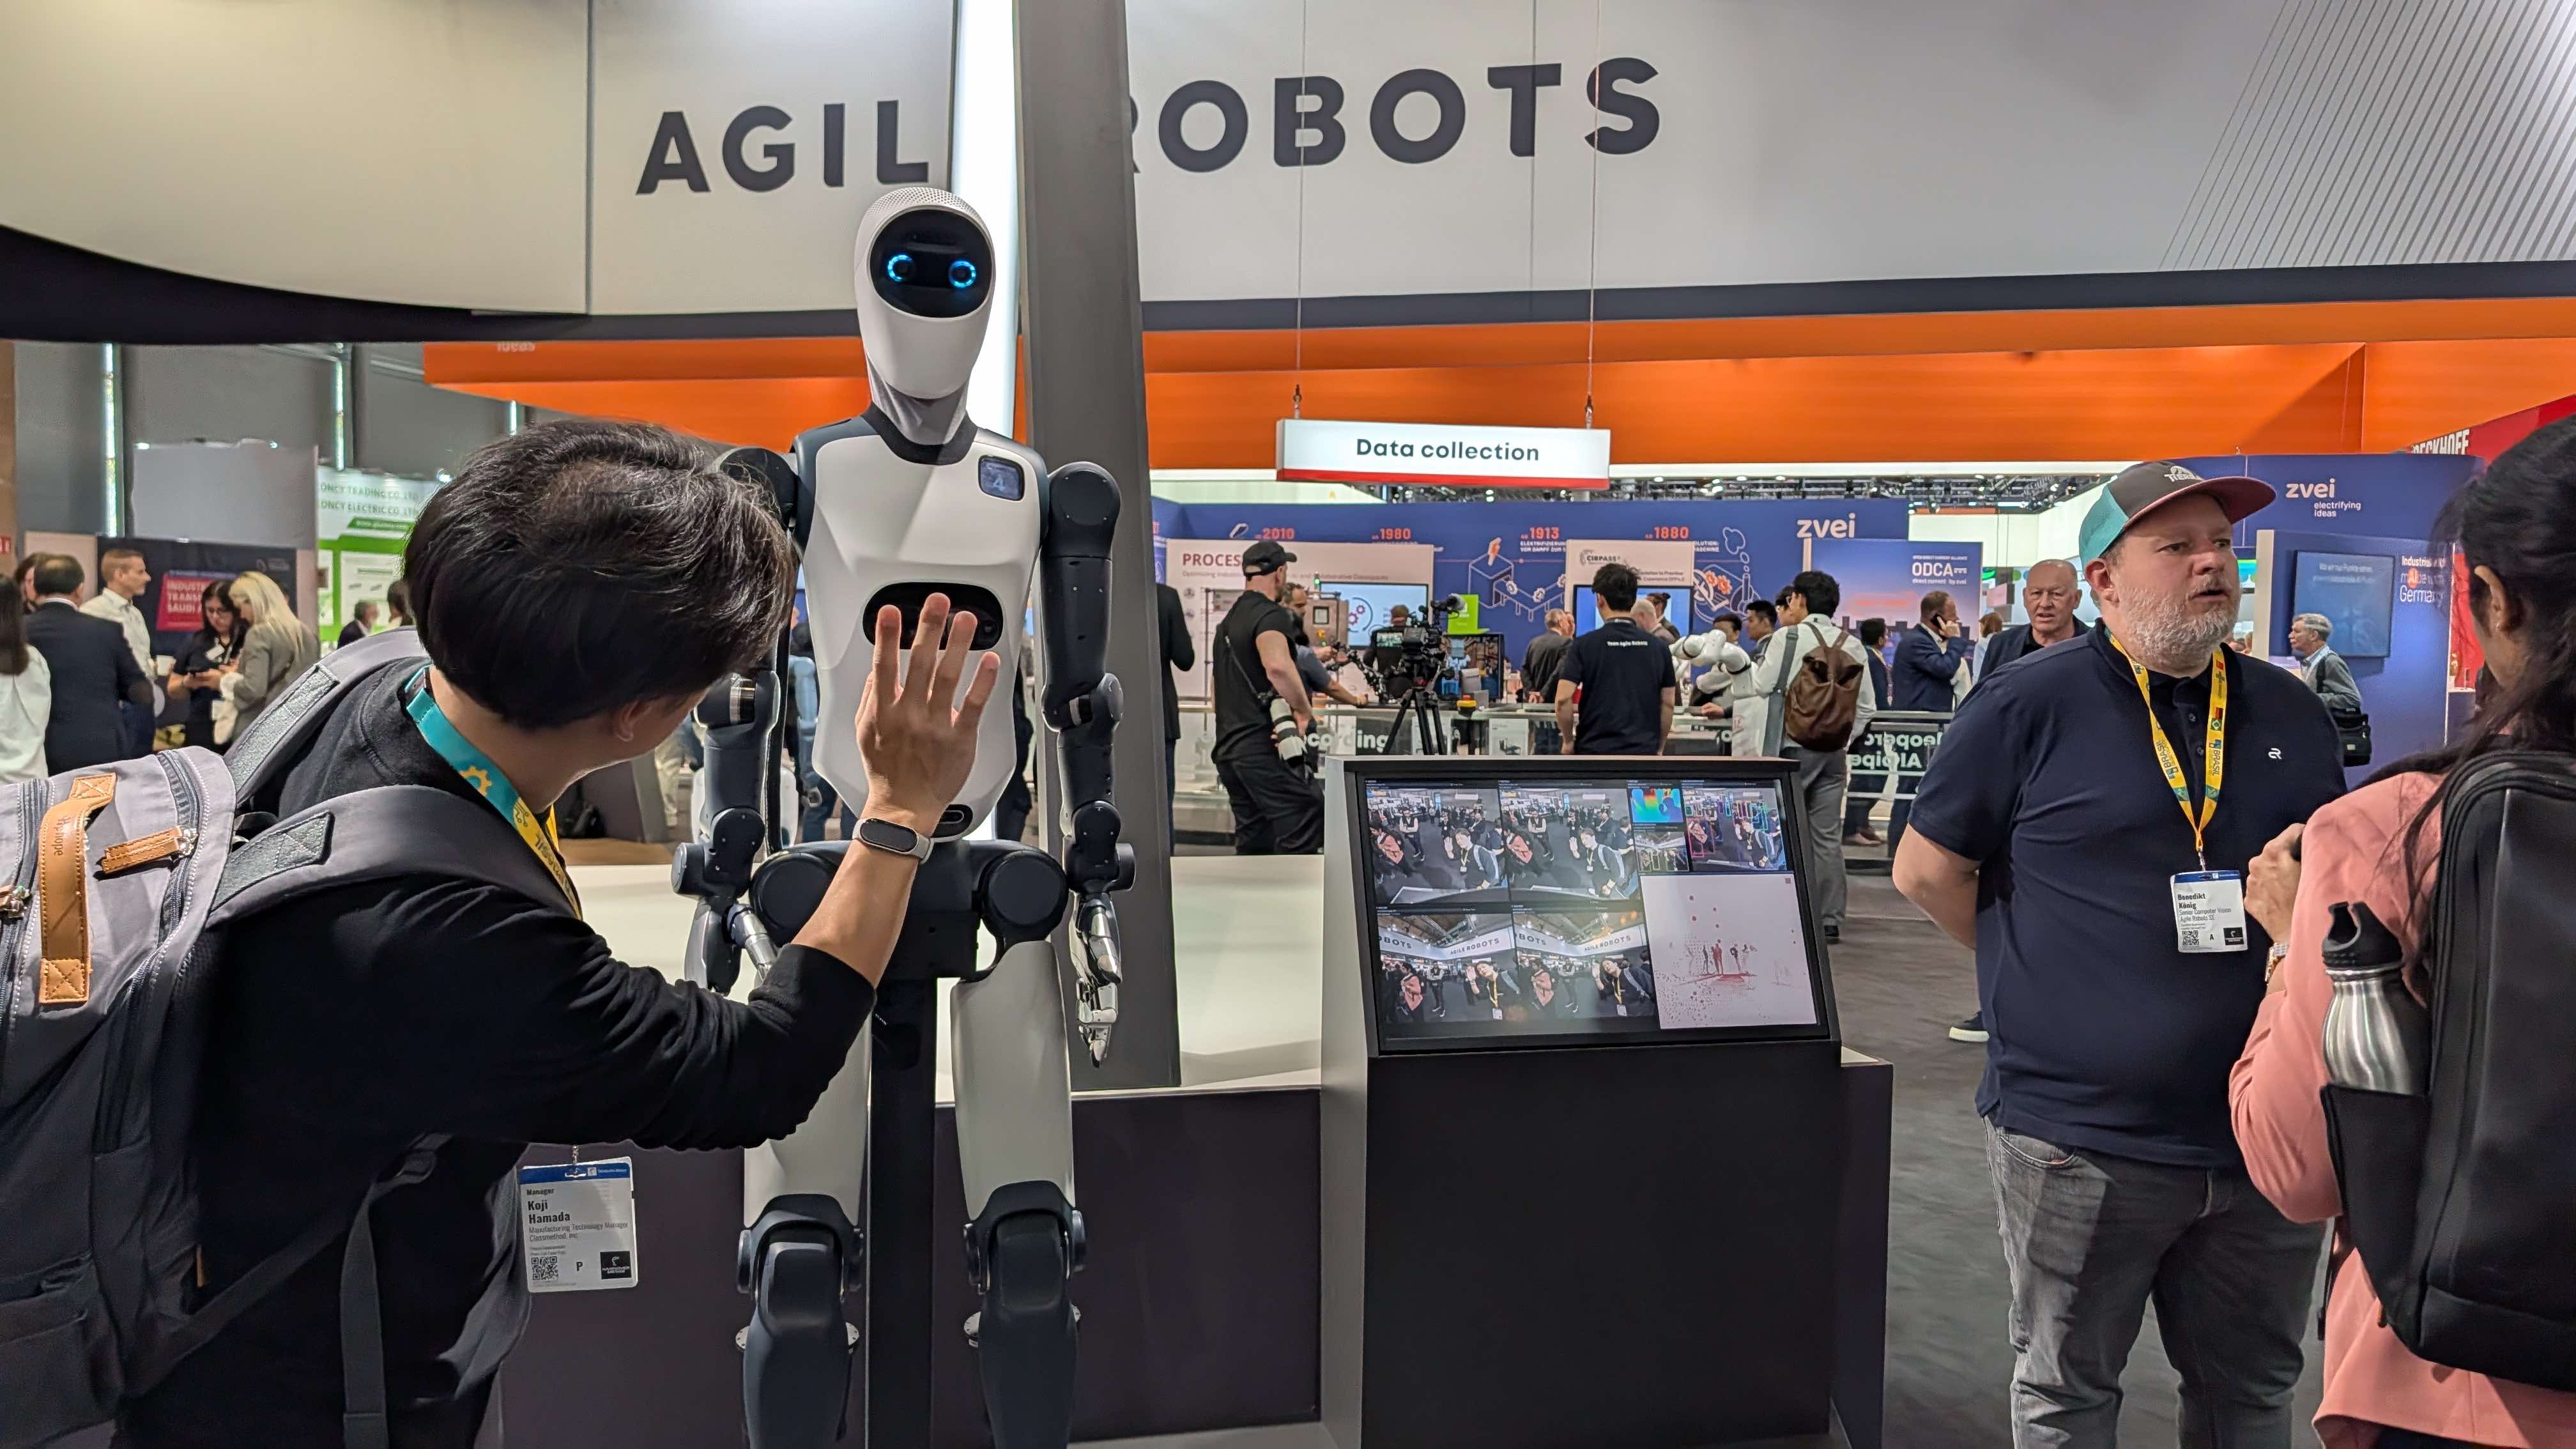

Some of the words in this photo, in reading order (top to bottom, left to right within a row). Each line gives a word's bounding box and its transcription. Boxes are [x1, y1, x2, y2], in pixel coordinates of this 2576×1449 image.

[636, 100, 929, 195] AGIL
[1130, 57, 1660, 174] OBOTS
[1356, 438, 1414, 457] Data
[1421, 441, 1539, 461] collection
[2285, 478, 2336, 498] zvei
[2313, 501, 2362, 511] electrifying
[2314, 509, 2336, 518] ideas
[1797, 512, 1856, 538] zvei
[1262, 528, 1295, 540] 2010
[1379, 528, 1411, 540] 1980
[1529, 527, 1560, 540] 1913
[1654, 526, 1690, 539] 1880
[1912, 562, 1954, 577] ODCA
[2212, 749, 2221, 777] BRASIL
[2177, 893, 2206, 901] Benedikt
[2178, 901, 2197, 910] König
[1515, 933, 1547, 946] BOTS
[526, 1188, 555, 1196] Manager
[527, 1199, 549, 1211] Koji
[528, 1211, 571, 1224] Hamada
[576, 1261, 583, 1271] P
